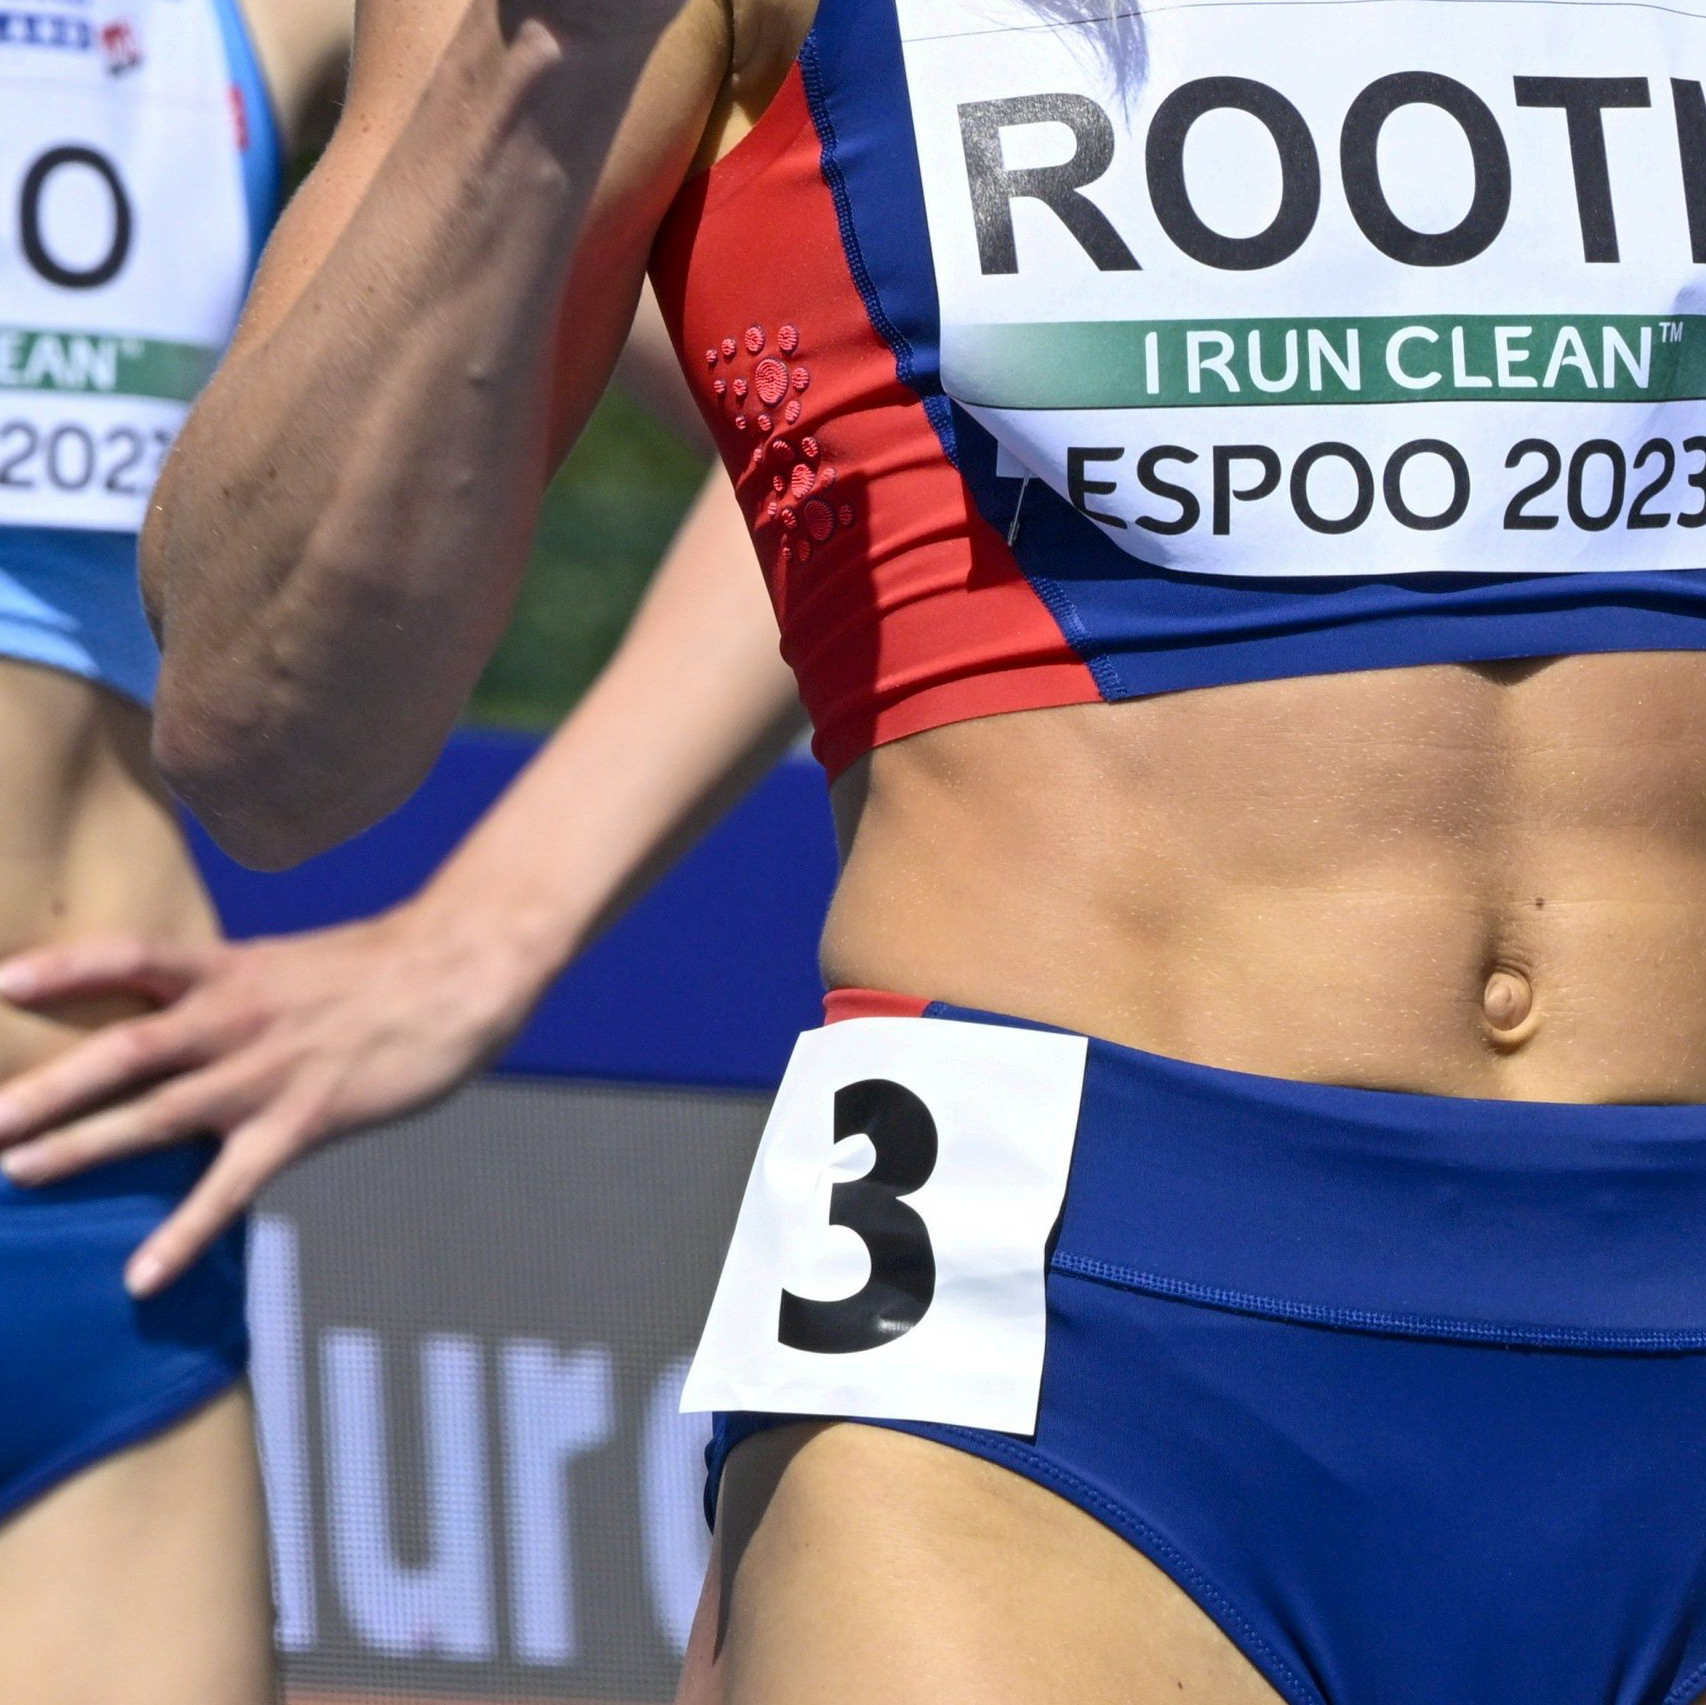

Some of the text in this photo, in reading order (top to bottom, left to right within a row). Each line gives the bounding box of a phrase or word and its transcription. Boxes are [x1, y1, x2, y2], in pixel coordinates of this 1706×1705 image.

[1144, 330, 1161, 395] I
[1185, 327, 1361, 395] RUN
[1066, 438, 1471, 536] ESPOO
[777, 1077, 939, 1355] 3
